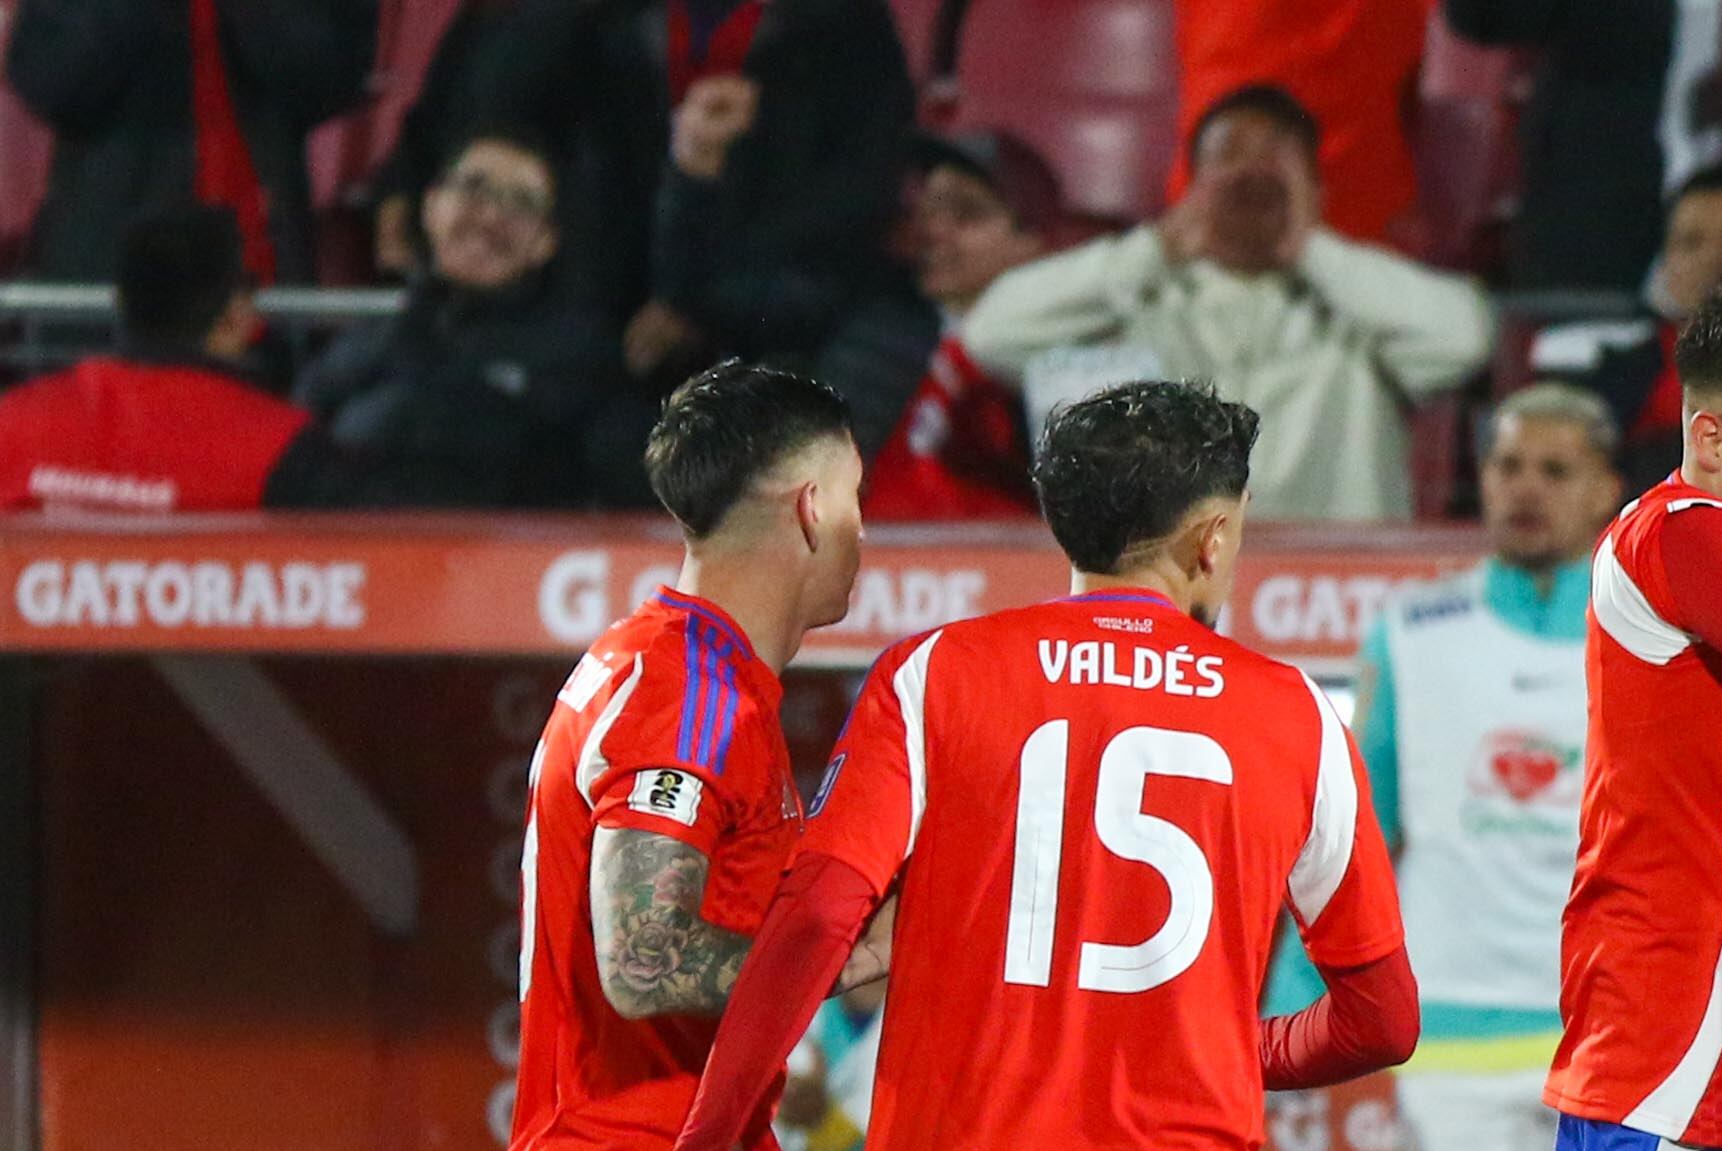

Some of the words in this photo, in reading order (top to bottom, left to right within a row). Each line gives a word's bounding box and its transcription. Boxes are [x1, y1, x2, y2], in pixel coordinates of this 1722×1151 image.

[15, 560, 367, 628] GATORADE
[538, 549, 611, 641] G
[1037, 639, 1225, 699] VALDÉS
[1003, 718, 1234, 994] 15
